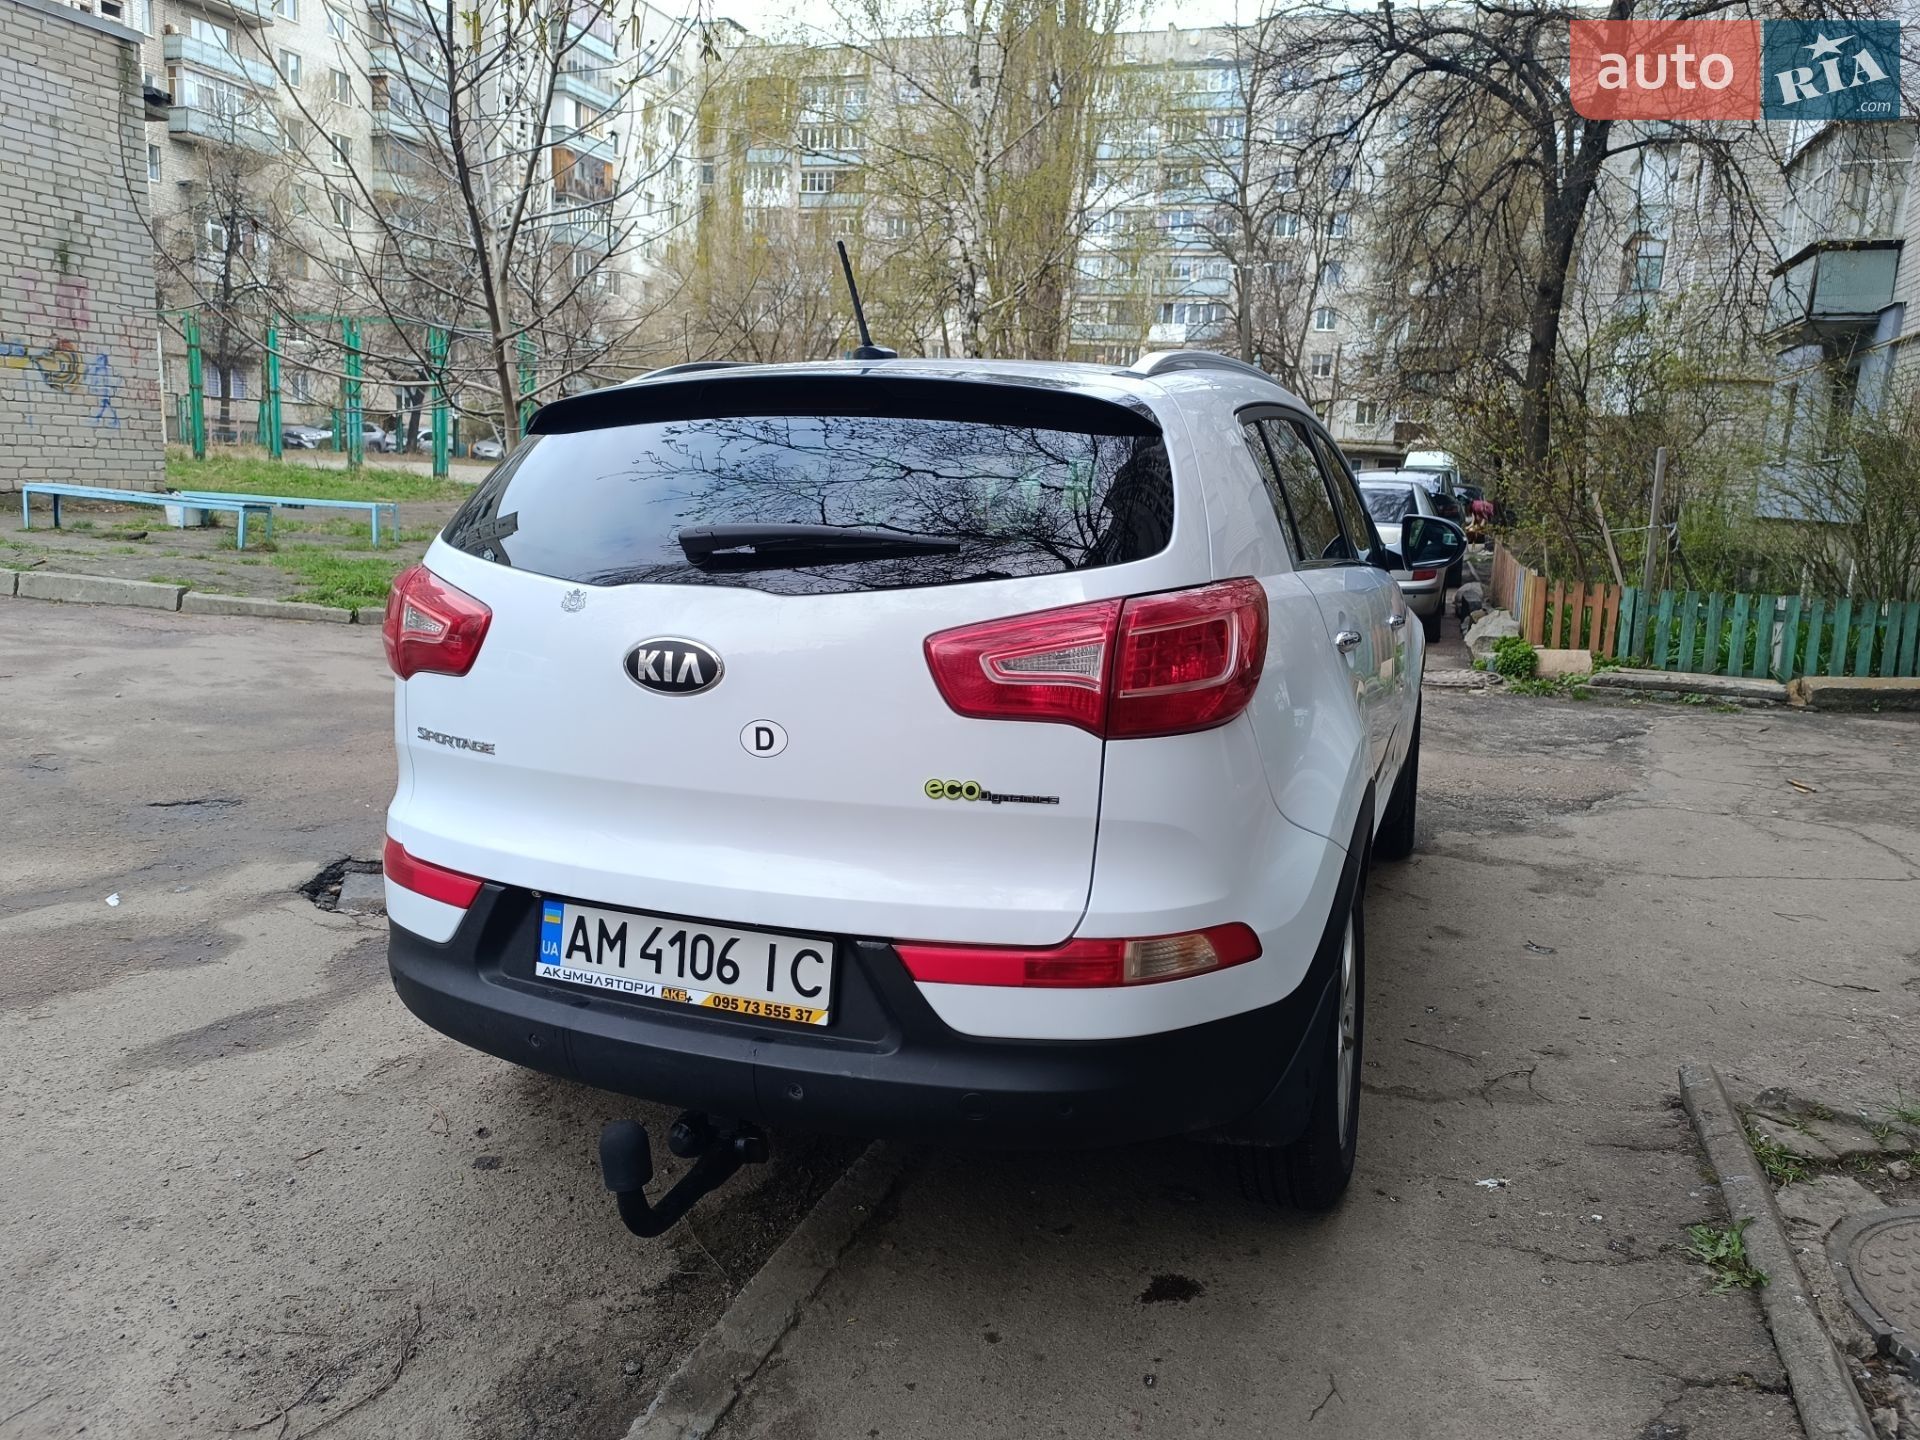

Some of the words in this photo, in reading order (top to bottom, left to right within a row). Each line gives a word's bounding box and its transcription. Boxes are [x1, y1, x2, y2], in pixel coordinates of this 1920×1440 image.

[637, 649, 704, 684] KIA
[417, 726, 496, 756] SPORTAGE
[755, 726, 775, 751] D
[541, 939, 560, 957] UA
[565, 914, 628, 969] AM
[639, 926, 741, 985] 4106
[542, 966, 655, 996] АКУМУЛЯТОРИ
[712, 995, 739, 1011] 095
[743, 1000, 761, 1015] 73
[764, 1003, 791, 1019] 555
[794, 1008, 813, 1022] 37
